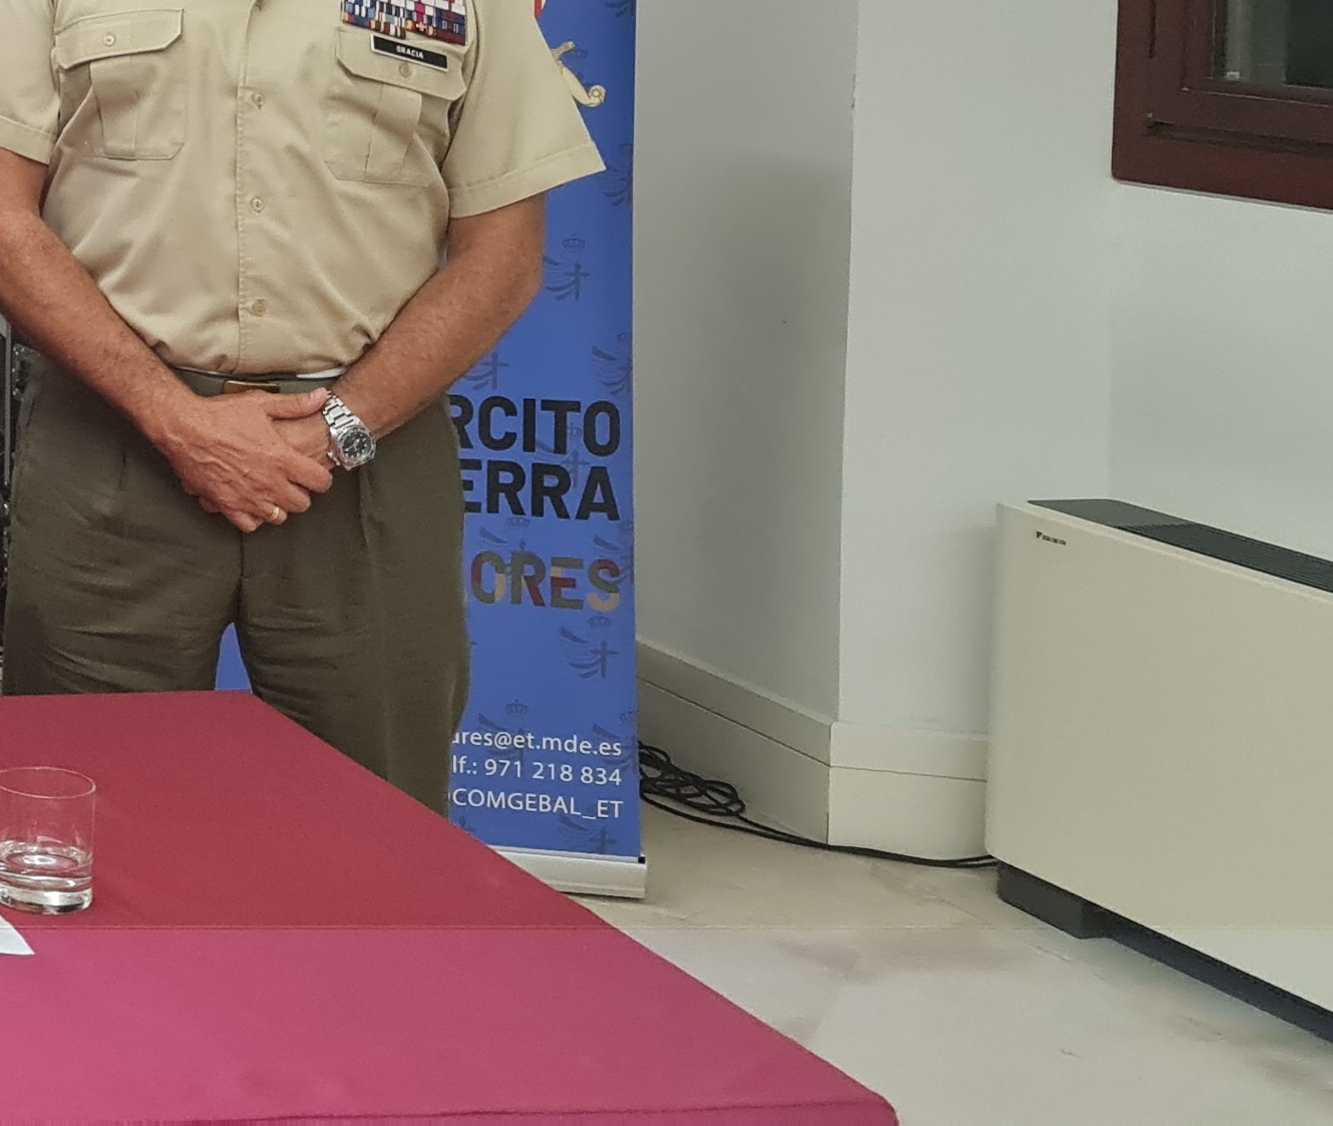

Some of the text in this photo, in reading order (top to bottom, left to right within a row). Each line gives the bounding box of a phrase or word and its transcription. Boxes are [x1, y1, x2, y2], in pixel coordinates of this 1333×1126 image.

[484, 758, 522, 778] 971
[532, 762, 574, 782] 218
[580, 766, 623, 786] 834
[448, 788, 624, 820] COMGEBAL_ET
